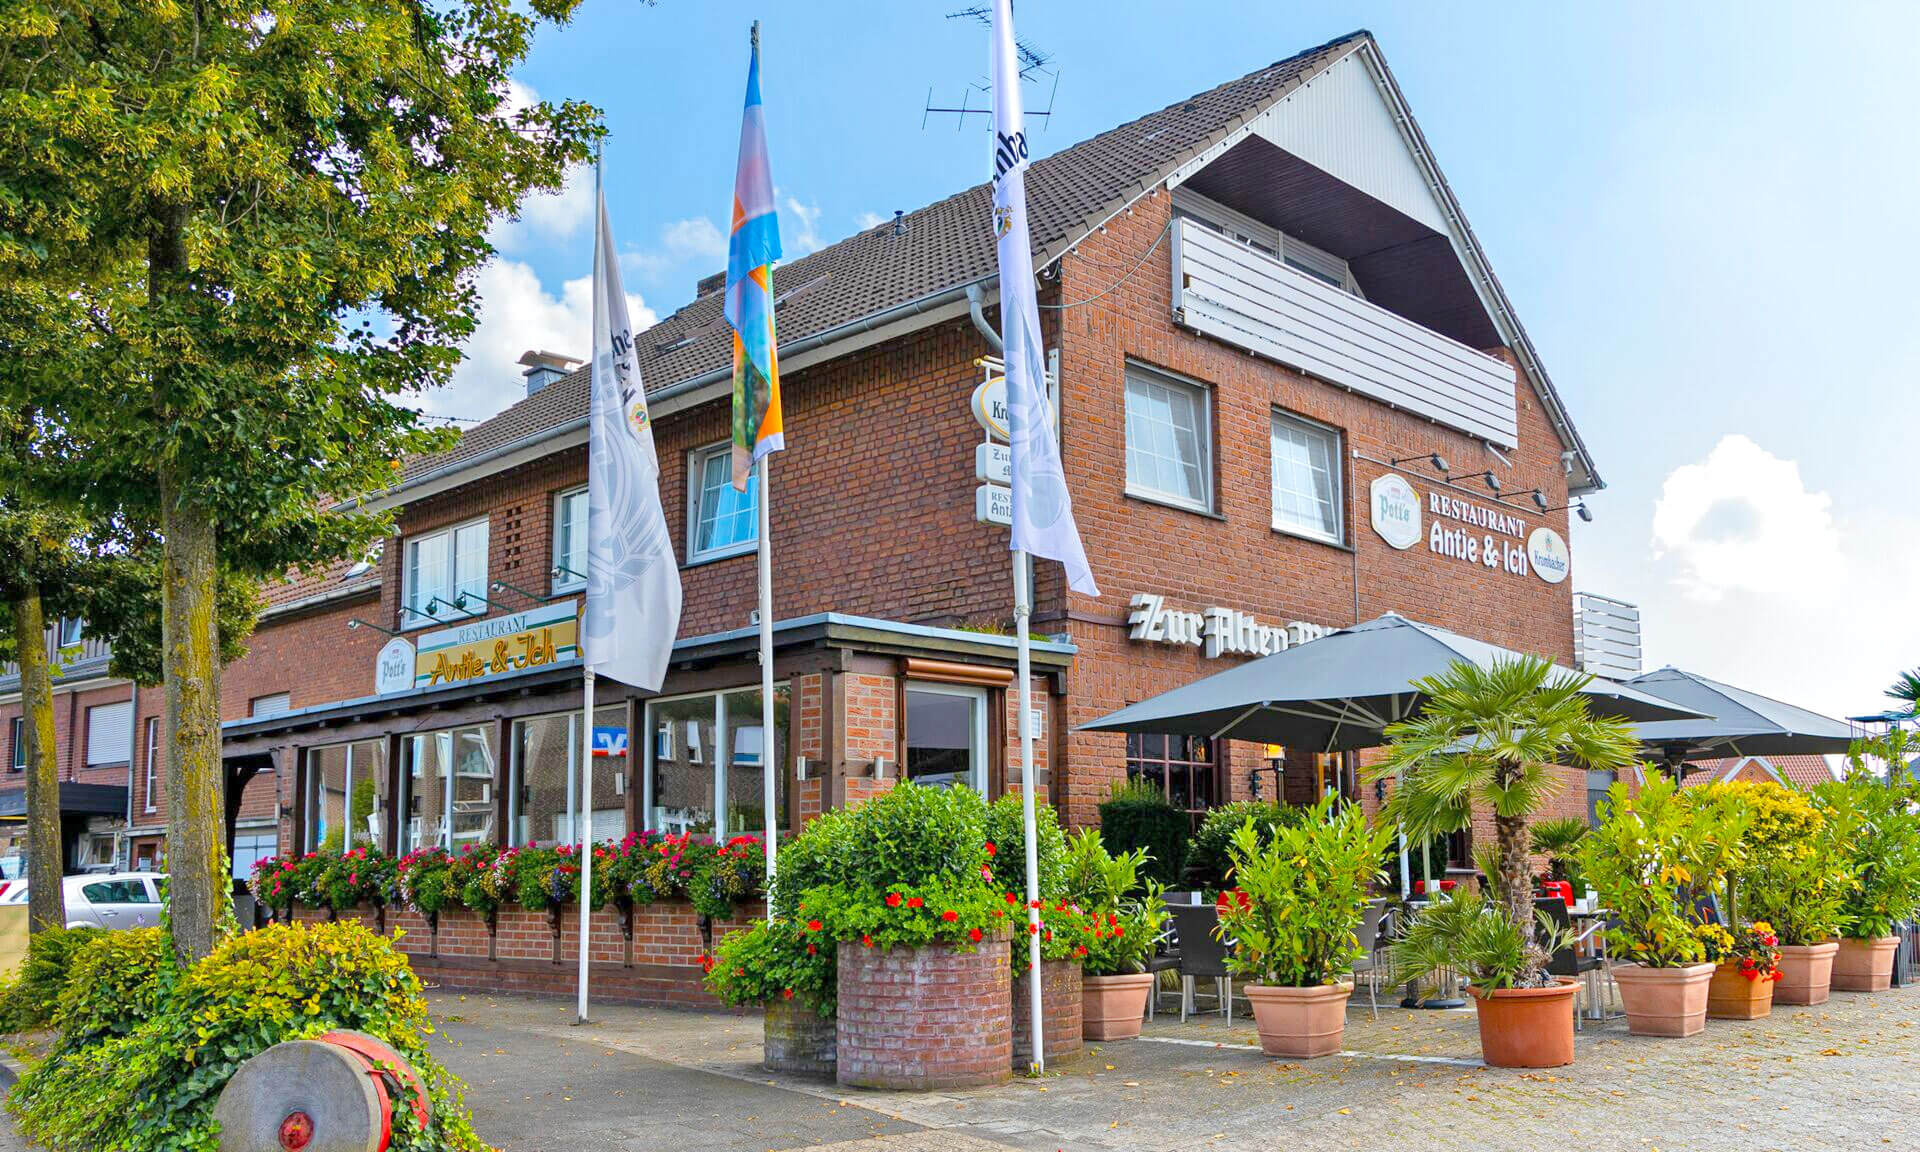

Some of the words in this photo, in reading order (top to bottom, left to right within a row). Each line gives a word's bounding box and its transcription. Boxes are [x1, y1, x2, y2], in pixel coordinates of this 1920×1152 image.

[1430, 491, 1526, 539] RESTAURANT
[1430, 520, 1477, 563] Antje
[1483, 534, 1498, 568] &
[1503, 540, 1528, 576] Ich
[457, 615, 527, 644] RESTAURANT
[1128, 593, 1204, 647] Zur
[1203, 606, 1290, 659] Alten
[490, 640, 509, 672] &
